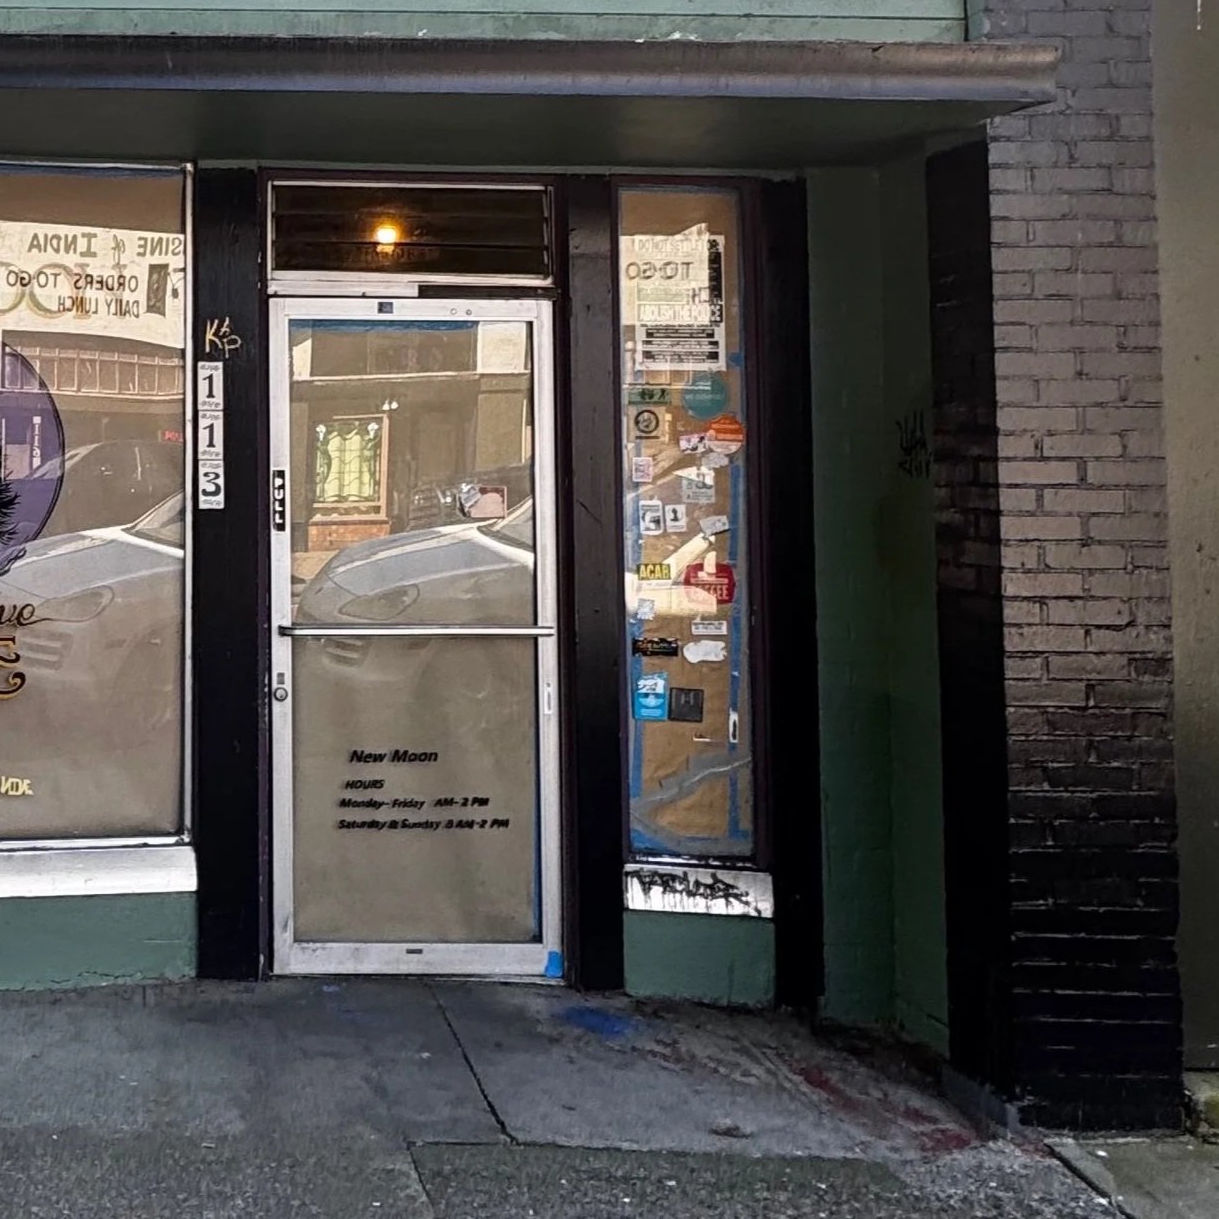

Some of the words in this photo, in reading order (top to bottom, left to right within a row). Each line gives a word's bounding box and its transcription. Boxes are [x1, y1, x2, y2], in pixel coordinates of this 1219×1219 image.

[274, 477, 284, 524] PULL
[639, 564, 670, 580] ACAB
[349, 749, 387, 763] New
[391, 749, 439, 763] Moon
[344, 780, 385, 790] HOURS
[391, 798, 425, 810] Friday
[338, 819, 387, 831] Saturday
[400, 819, 441, 831] Sunday
[489, 818, 510, 829] PM
